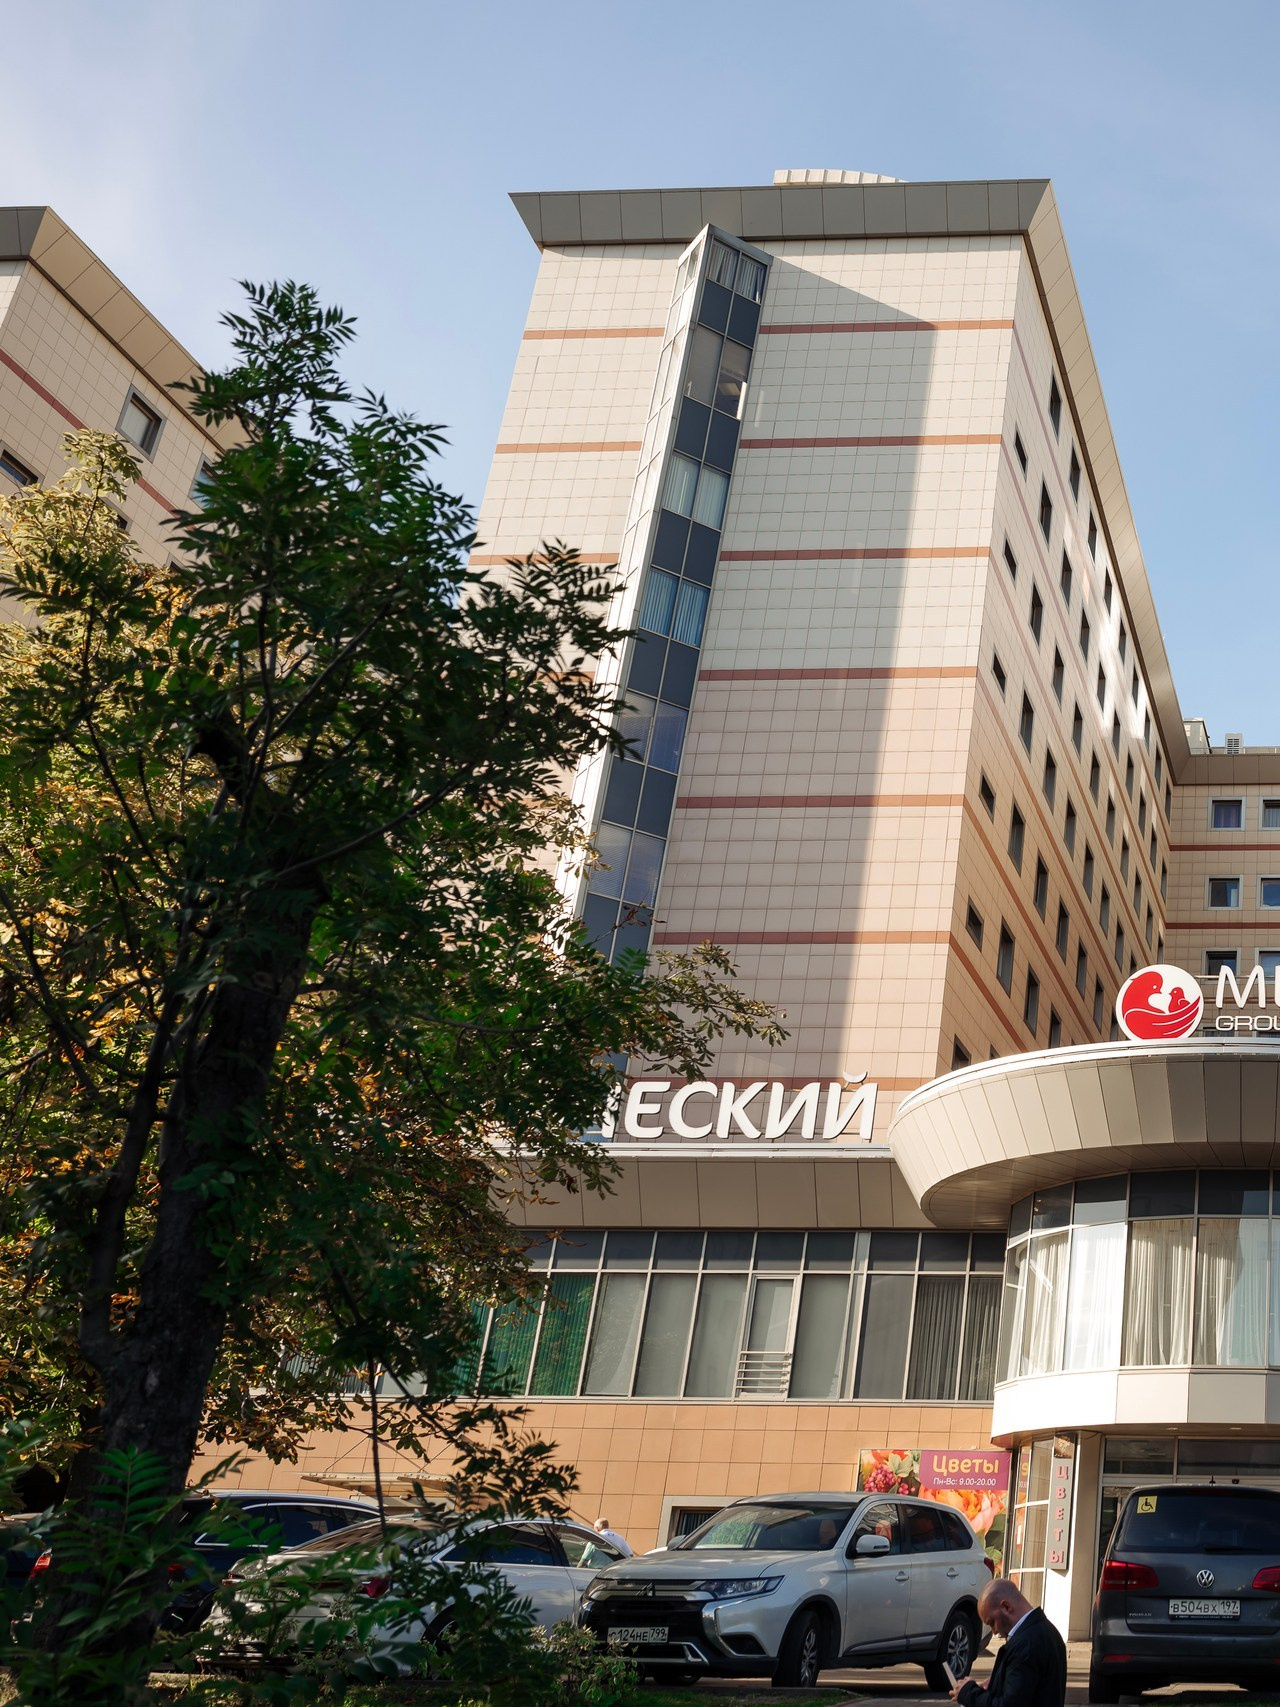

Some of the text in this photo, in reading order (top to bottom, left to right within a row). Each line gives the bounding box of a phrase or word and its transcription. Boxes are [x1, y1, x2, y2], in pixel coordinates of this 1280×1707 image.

[933, 1454, 999, 1477] Цветы
[933, 1477, 997, 1486] Пн-Вс: 9.00-20.00
[1050, 1464, 1069, 1564] ЦВЕТЫ
[1220, 1600, 1237, 1610] 197
